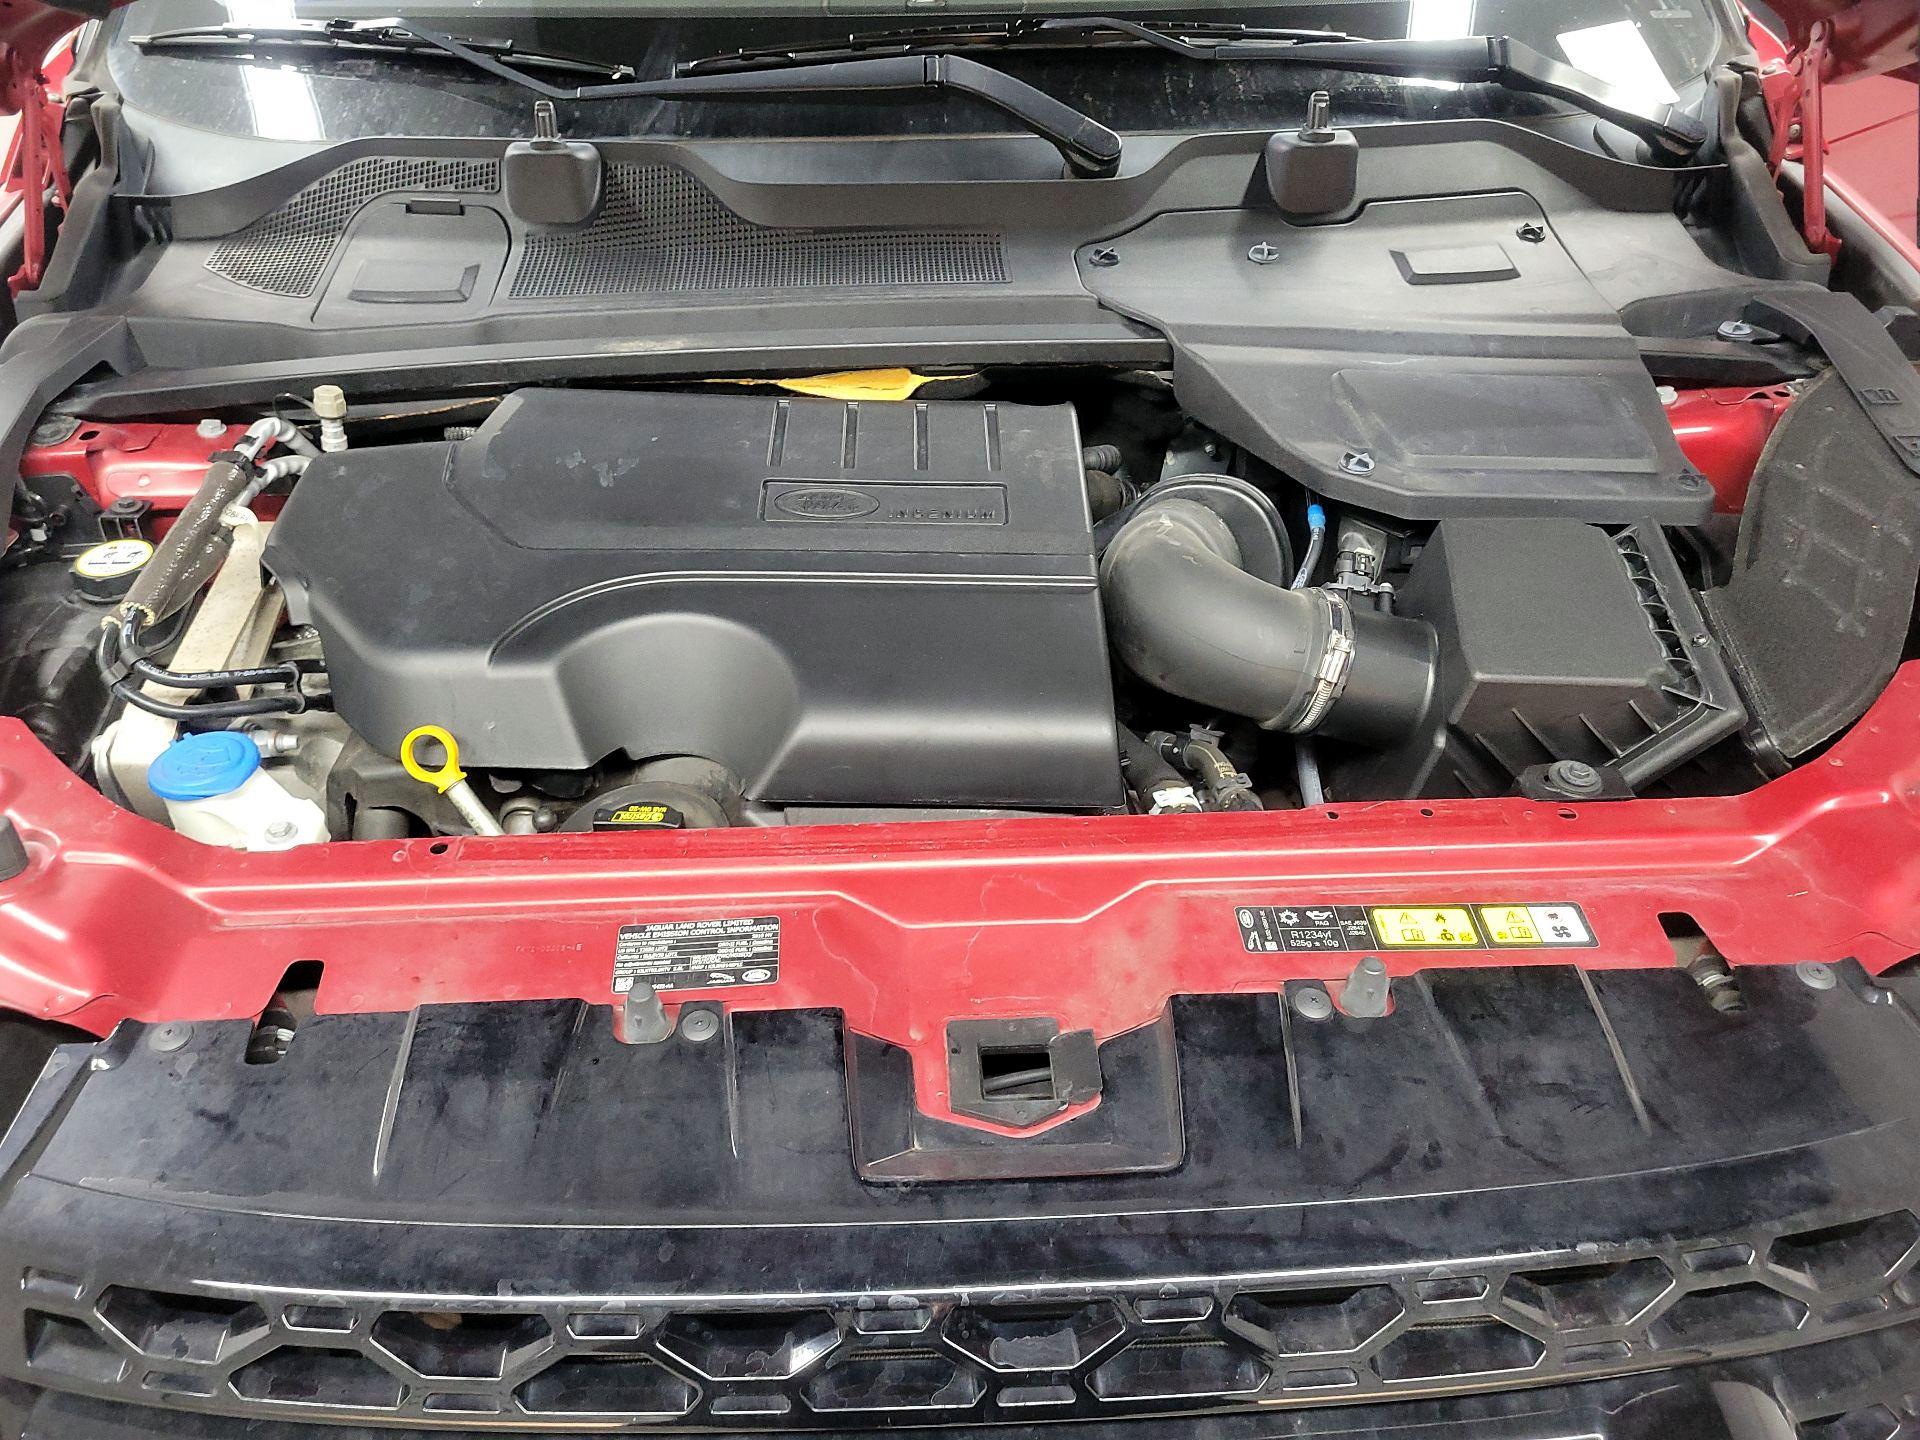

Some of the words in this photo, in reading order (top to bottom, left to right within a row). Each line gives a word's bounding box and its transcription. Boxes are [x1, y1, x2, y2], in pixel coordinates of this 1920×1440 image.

[888, 507, 996, 519] INGENIUM
[645, 923, 675, 932] JAGUAR
[675, 922, 695, 930] LAND
[696, 921, 722, 929] ROVER
[723, 919, 754, 928] LIMITED
[620, 932, 652, 940] VEHICLE
[652, 930, 689, 939] EMISSION
[690, 927, 726, 936] CONTROL
[726, 924, 778, 934] INFORMATION
[1291, 930, 1332, 941] R1234yf
[1323, 939, 1340, 948] 10g
